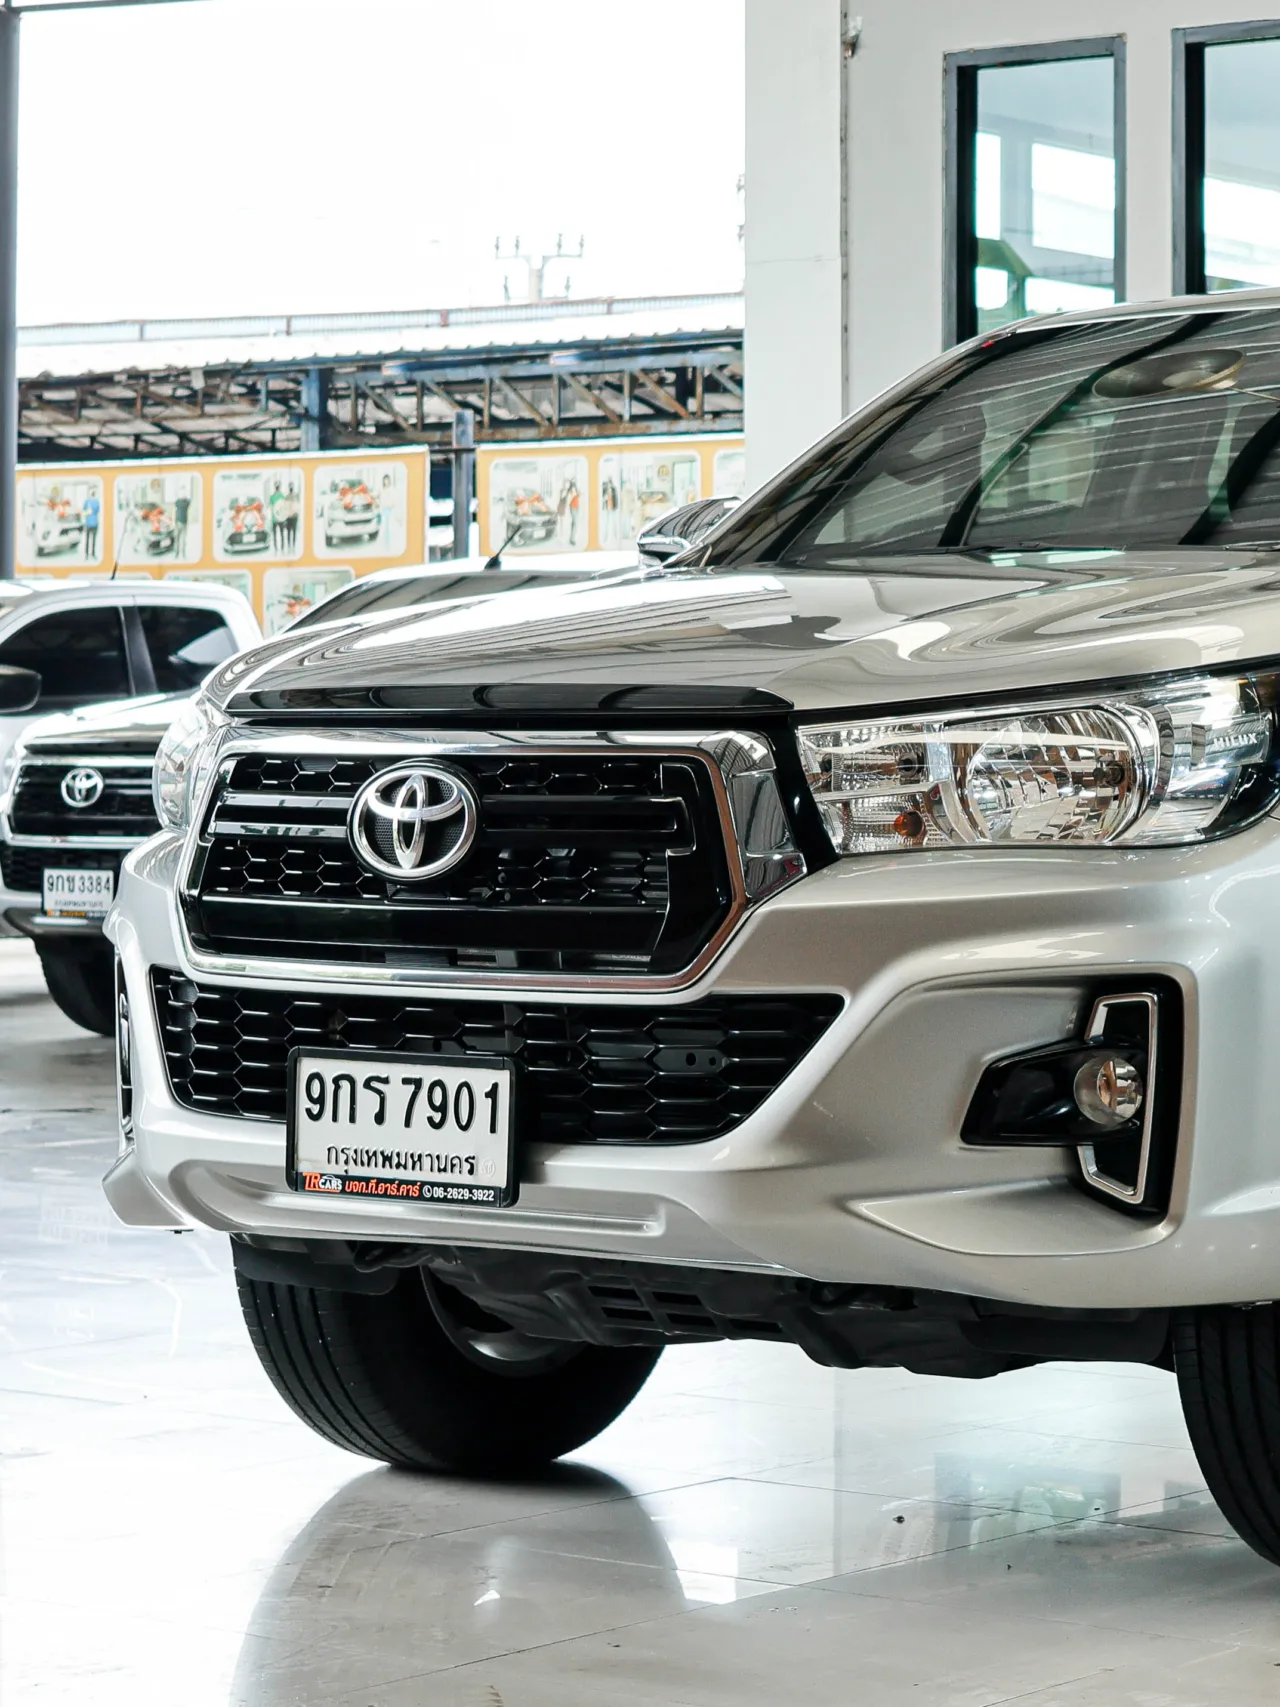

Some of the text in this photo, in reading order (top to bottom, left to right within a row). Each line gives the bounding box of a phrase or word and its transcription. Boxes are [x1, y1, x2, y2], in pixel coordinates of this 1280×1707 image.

[1213, 732, 1258, 750] HILUX
[78, 875, 111, 893] 3384
[304, 1071, 500, 1135] 9กร 7901
[326, 1144, 476, 1176] กรุงเทพมหานคร
[432, 1186, 495, 1201] 06-2629-3922
